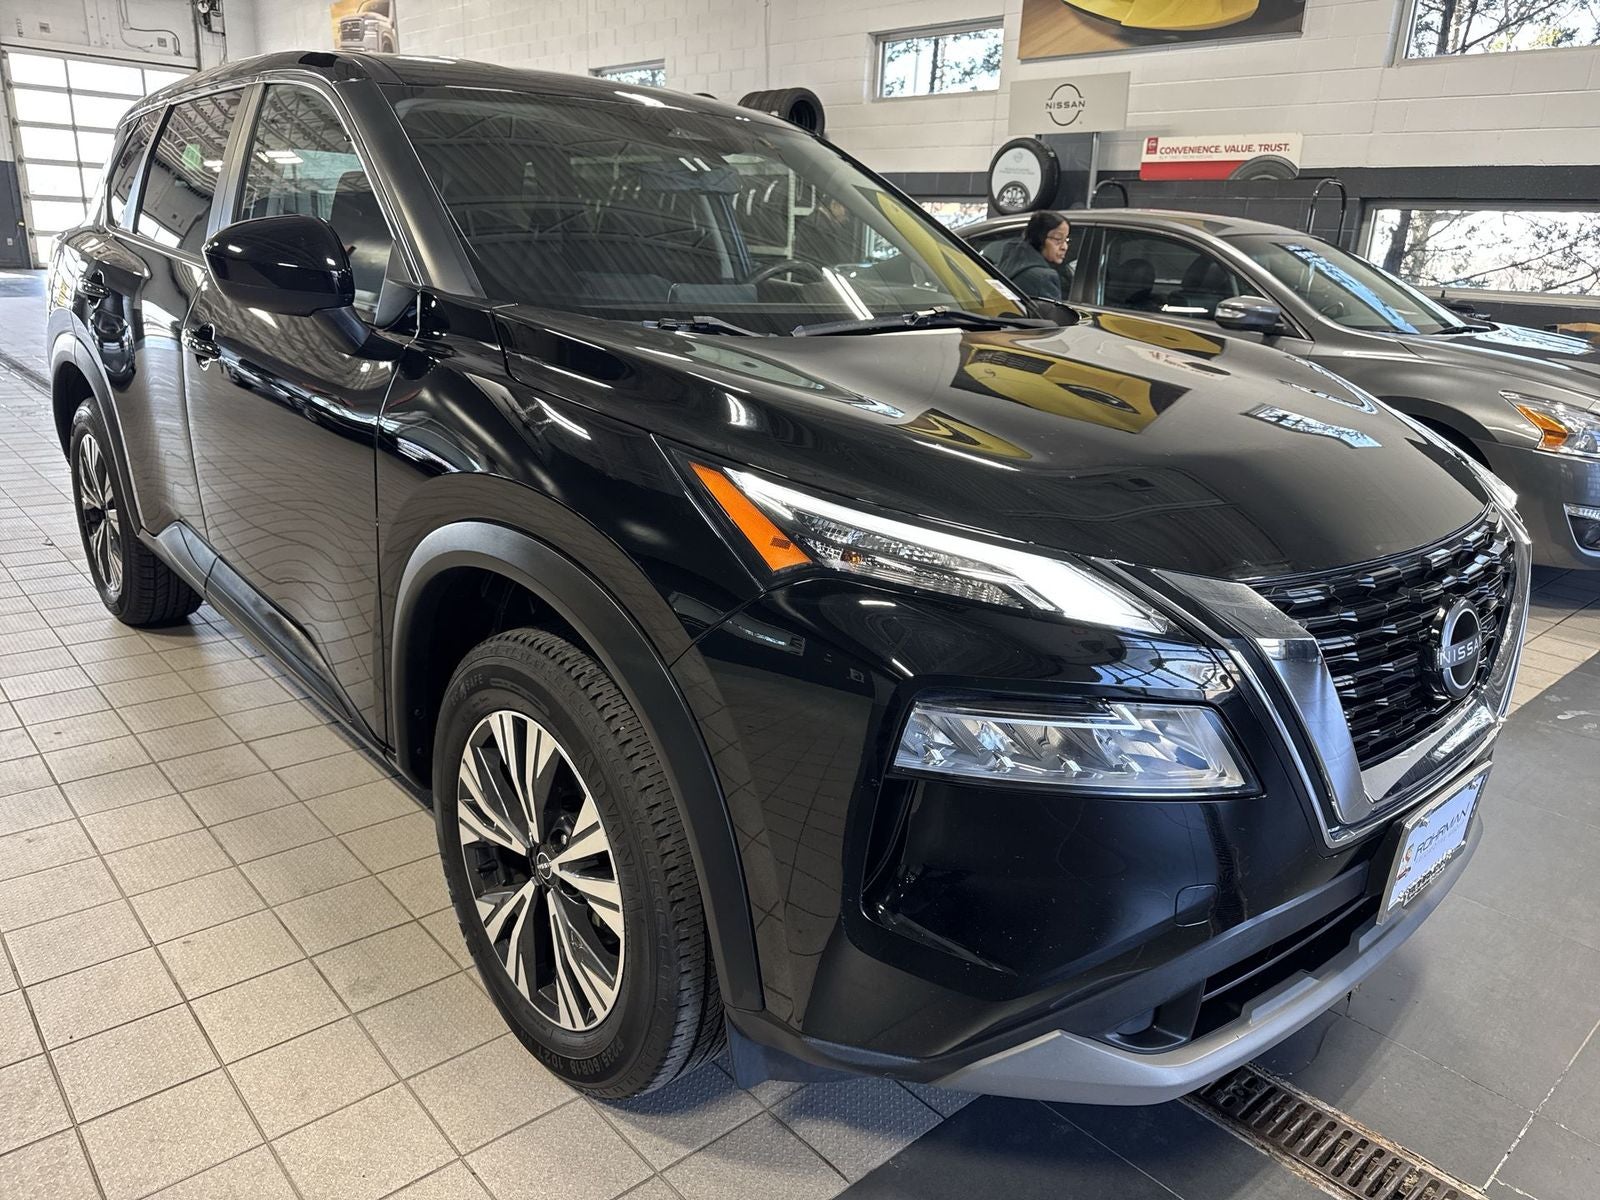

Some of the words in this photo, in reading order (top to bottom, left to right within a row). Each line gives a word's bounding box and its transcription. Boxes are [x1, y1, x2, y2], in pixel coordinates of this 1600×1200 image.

[1045, 100, 1086, 110] NISSAN
[1160, 144, 1222, 155] CONVENIENCE.
[1224, 143, 1256, 153] VALUE.
[1258, 142, 1290, 152] TRUST.
